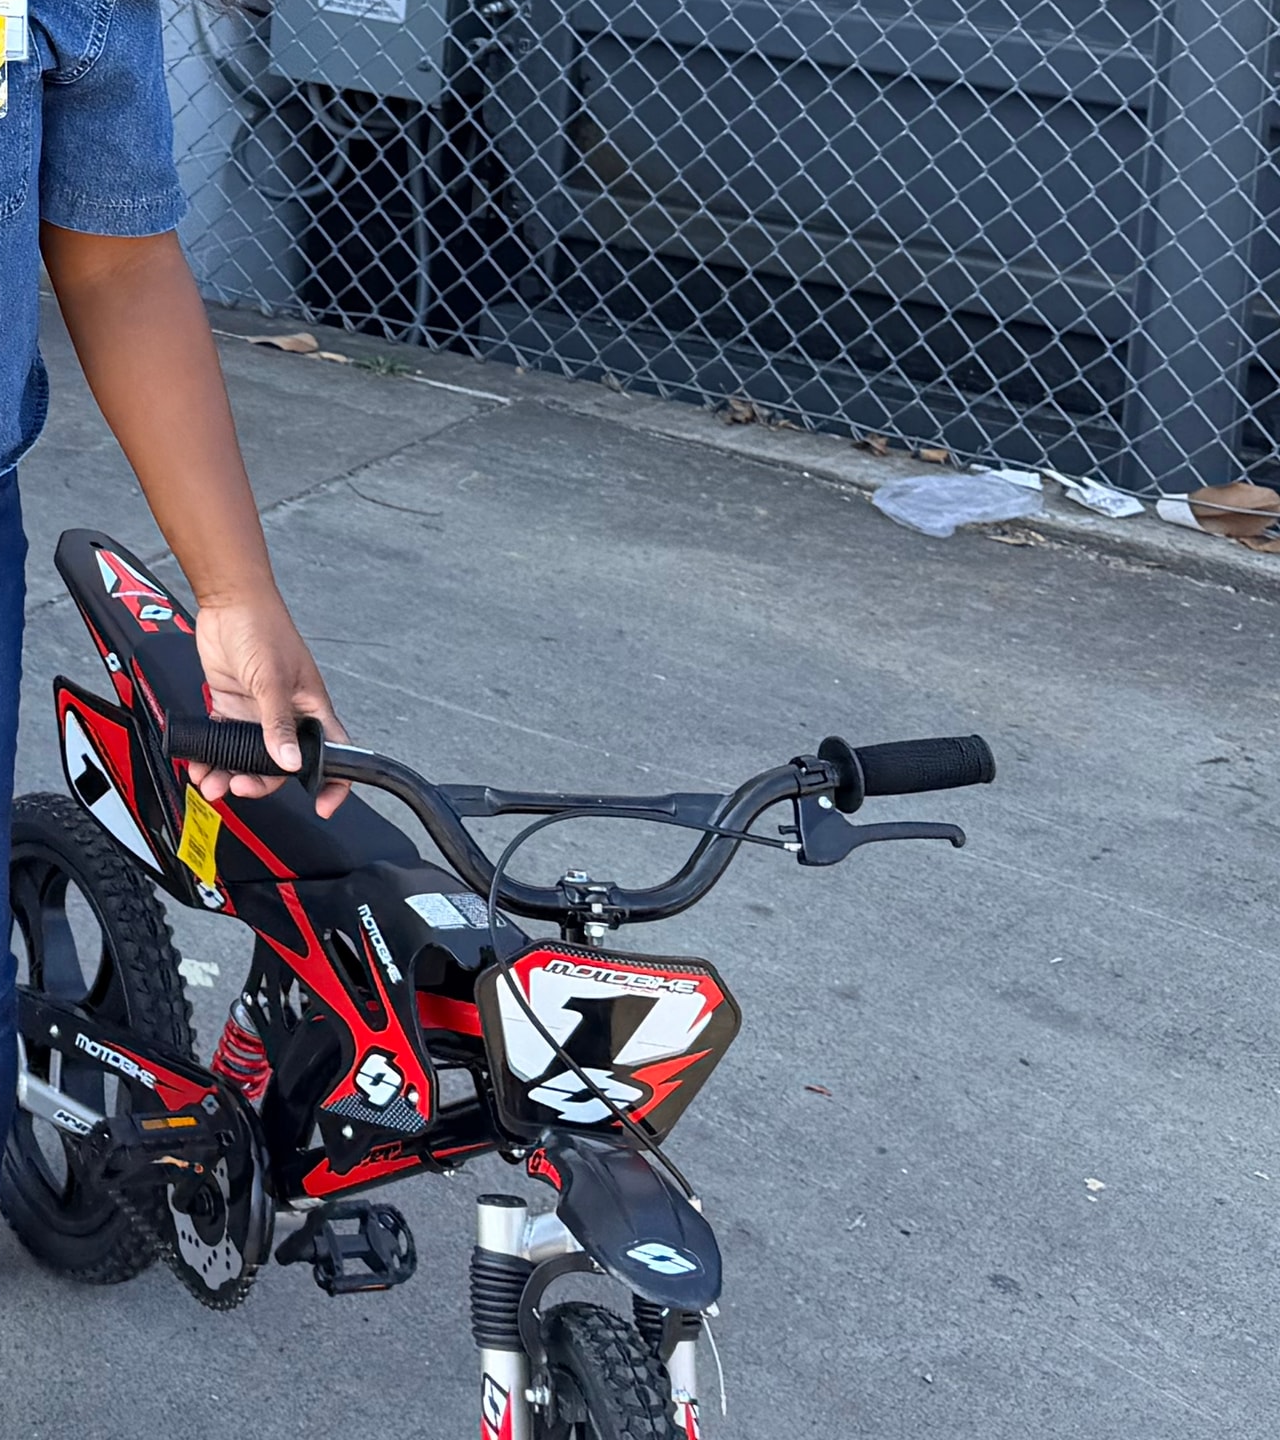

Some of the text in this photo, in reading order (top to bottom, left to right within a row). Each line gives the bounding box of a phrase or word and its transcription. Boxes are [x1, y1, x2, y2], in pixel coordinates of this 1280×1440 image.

[357, 903, 404, 985] MOTOBIKE
[543, 959, 700, 994] MOTOBIKE
[75, 1033, 158, 1091] MOTOBIKE
